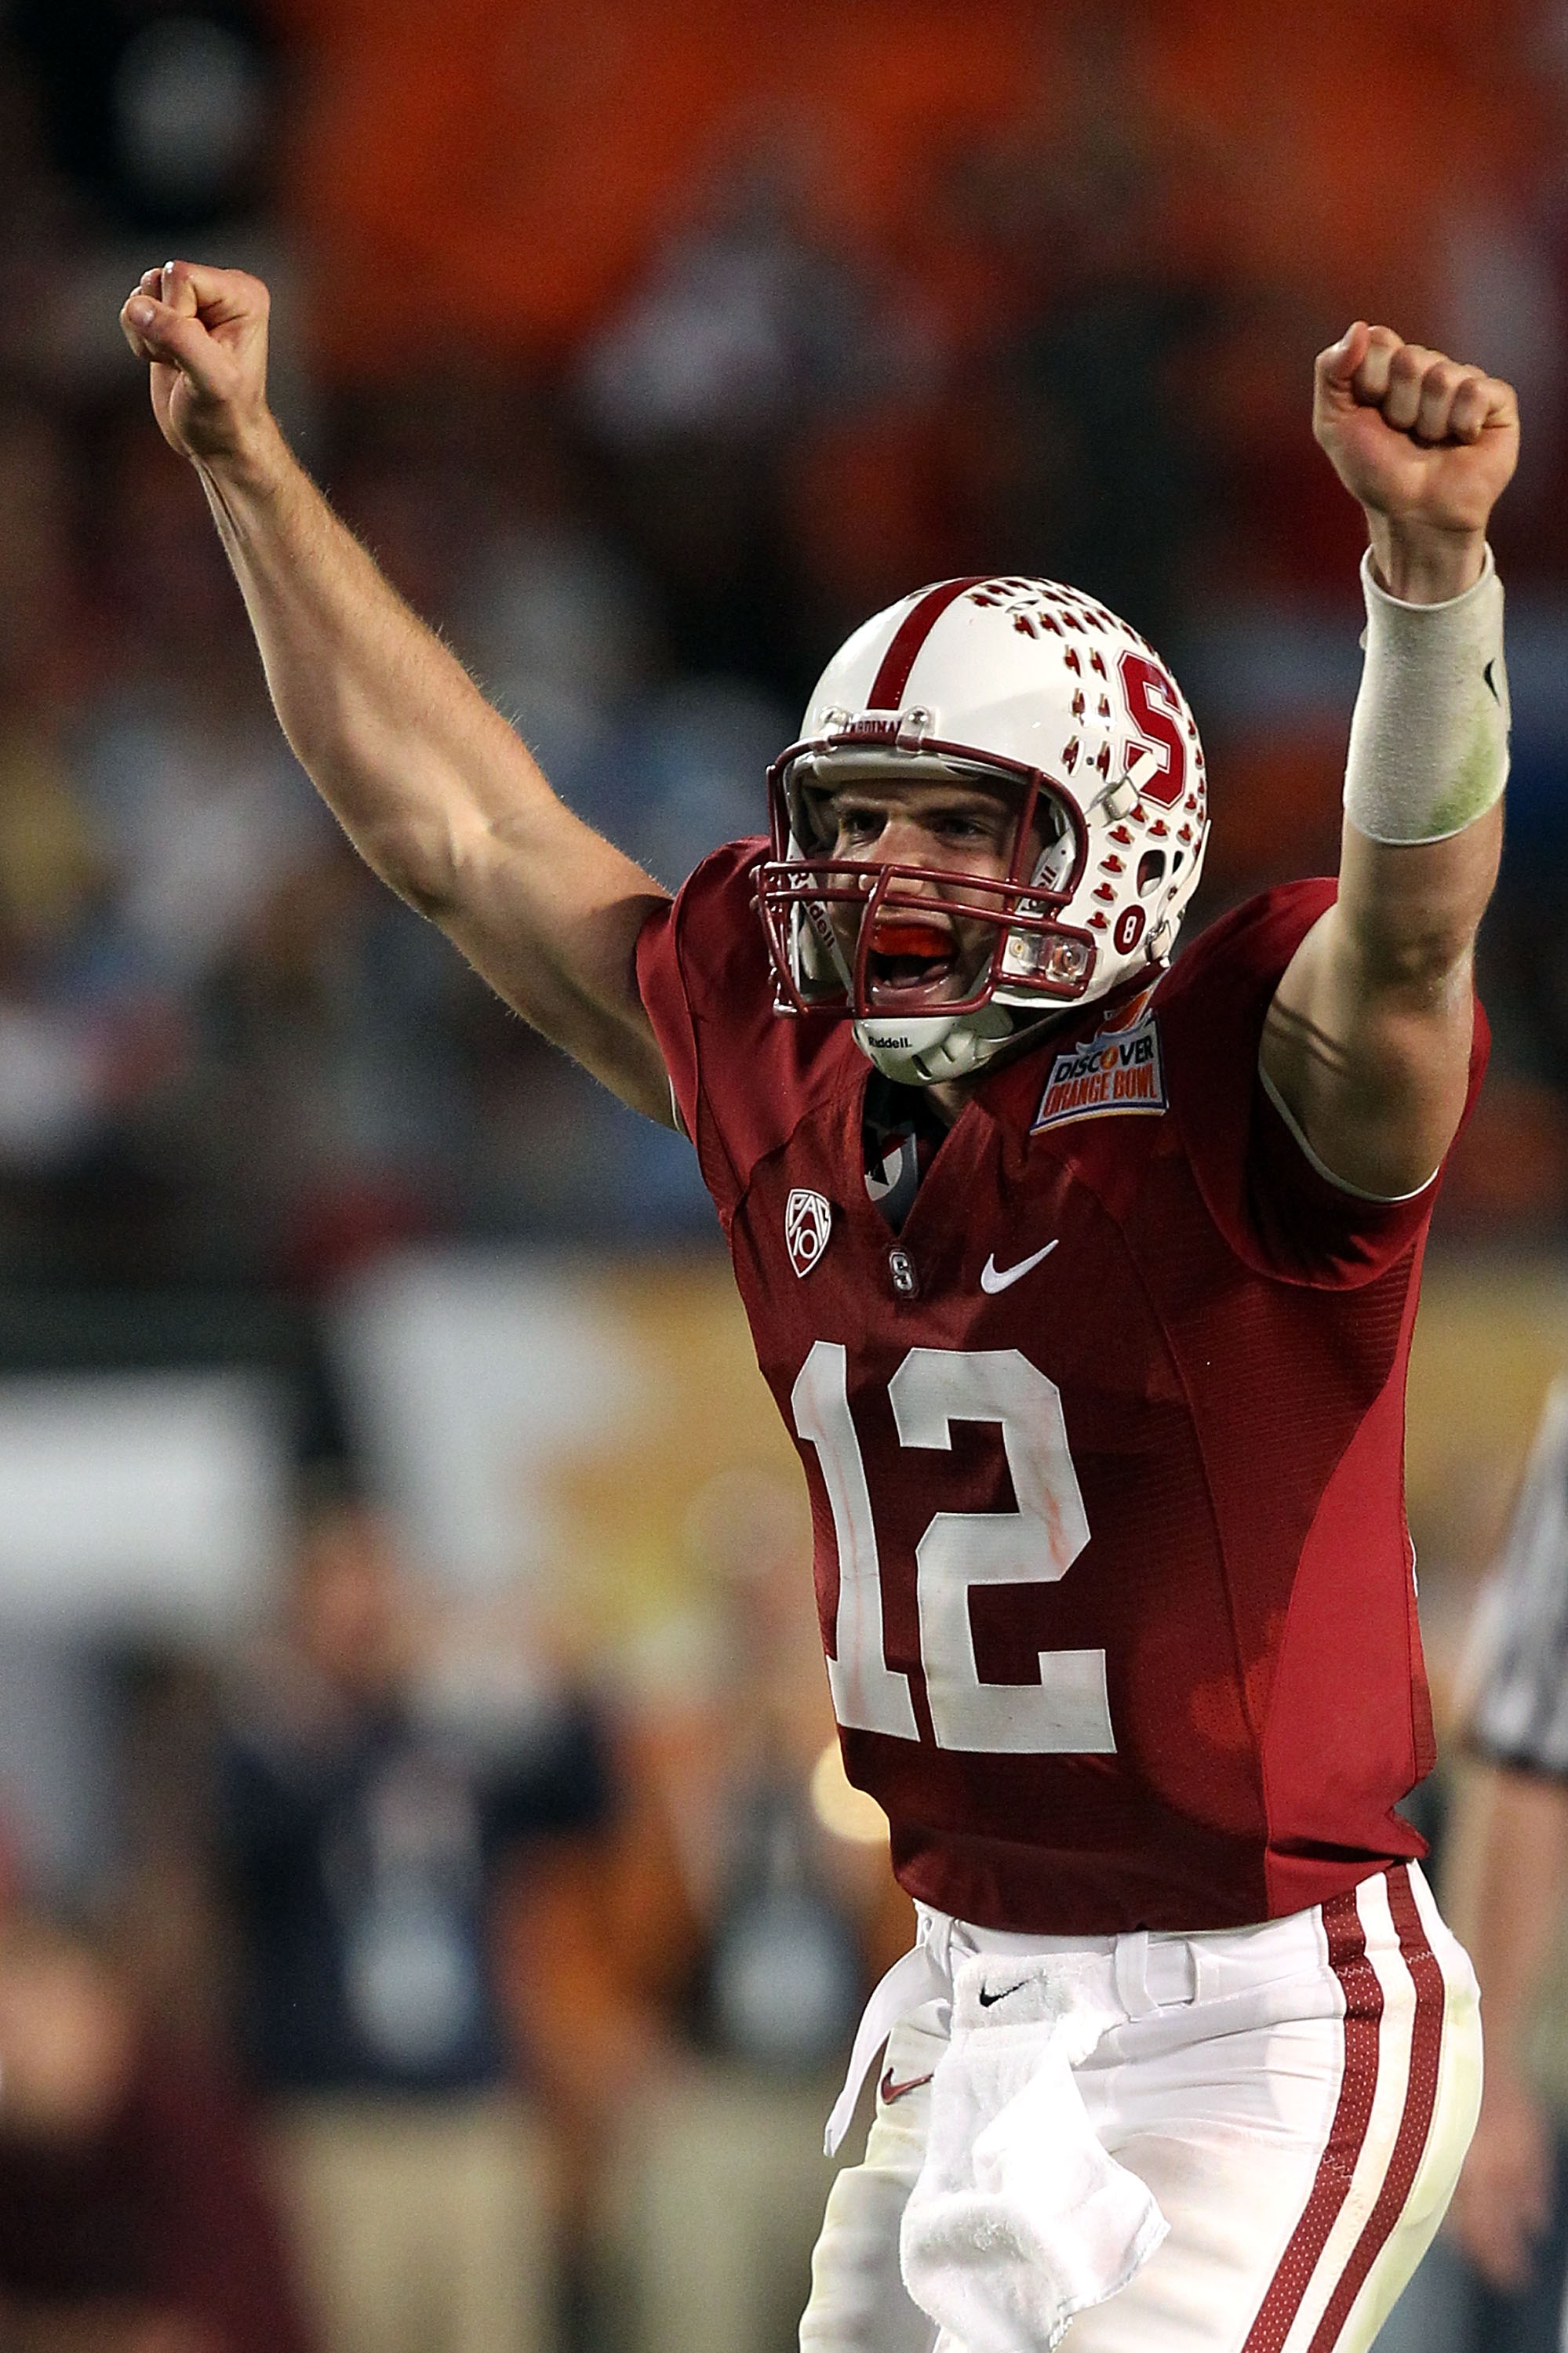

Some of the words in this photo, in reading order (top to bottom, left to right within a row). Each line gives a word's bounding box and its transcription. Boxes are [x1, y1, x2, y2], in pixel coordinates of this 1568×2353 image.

[1118, 650, 1185, 810] S
[1122, 915, 1137, 944] 8
[1054, 1035, 1154, 1083] DISCOVER
[1042, 1071, 1110, 1118] ORANGE
[1113, 1064, 1157, 1100] BOWL
[788, 1193, 830, 1248] PAC
[793, 1226, 818, 1260] 10
[890, 1252, 913, 1291] S
[791, 1340, 1117, 1755] 12
